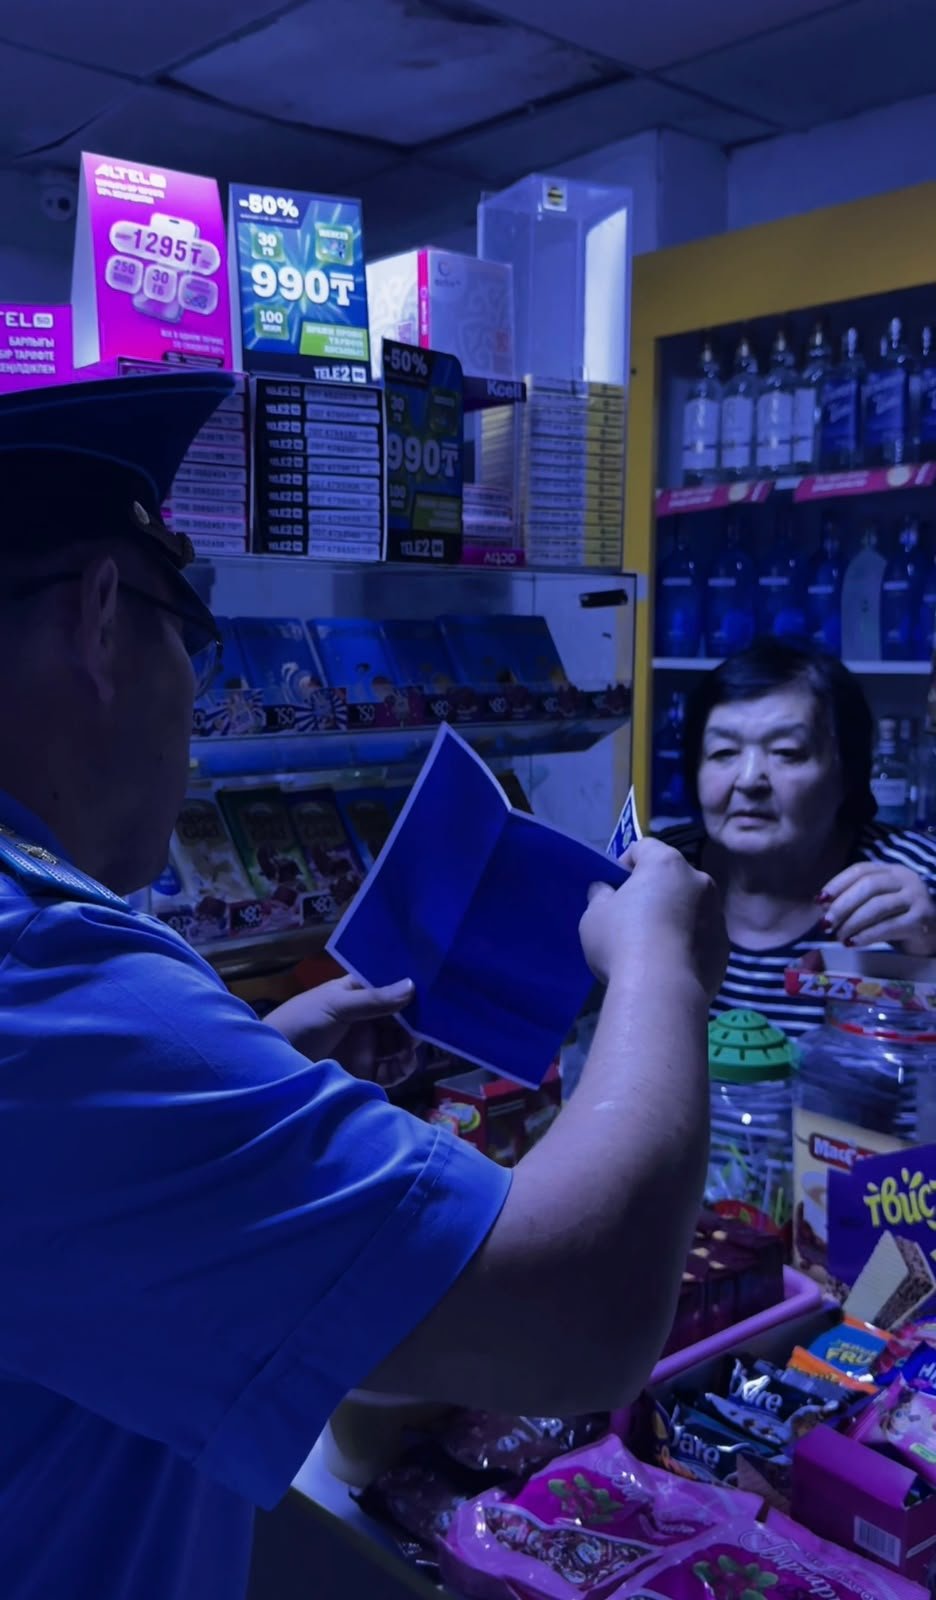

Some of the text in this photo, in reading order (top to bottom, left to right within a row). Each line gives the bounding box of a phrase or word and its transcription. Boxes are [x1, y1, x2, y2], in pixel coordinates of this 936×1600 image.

[238, 193, 299, 218] -50%
[257, 231, 277, 248] 30
[113, 259, 136, 275] 250
[152, 268, 169, 285] 30
[260, 309, 284, 325] 100
[384, 347, 428, 377] -50%
[313, 365, 351, 383] TELE2
[487, 379, 522, 399] Kcell
